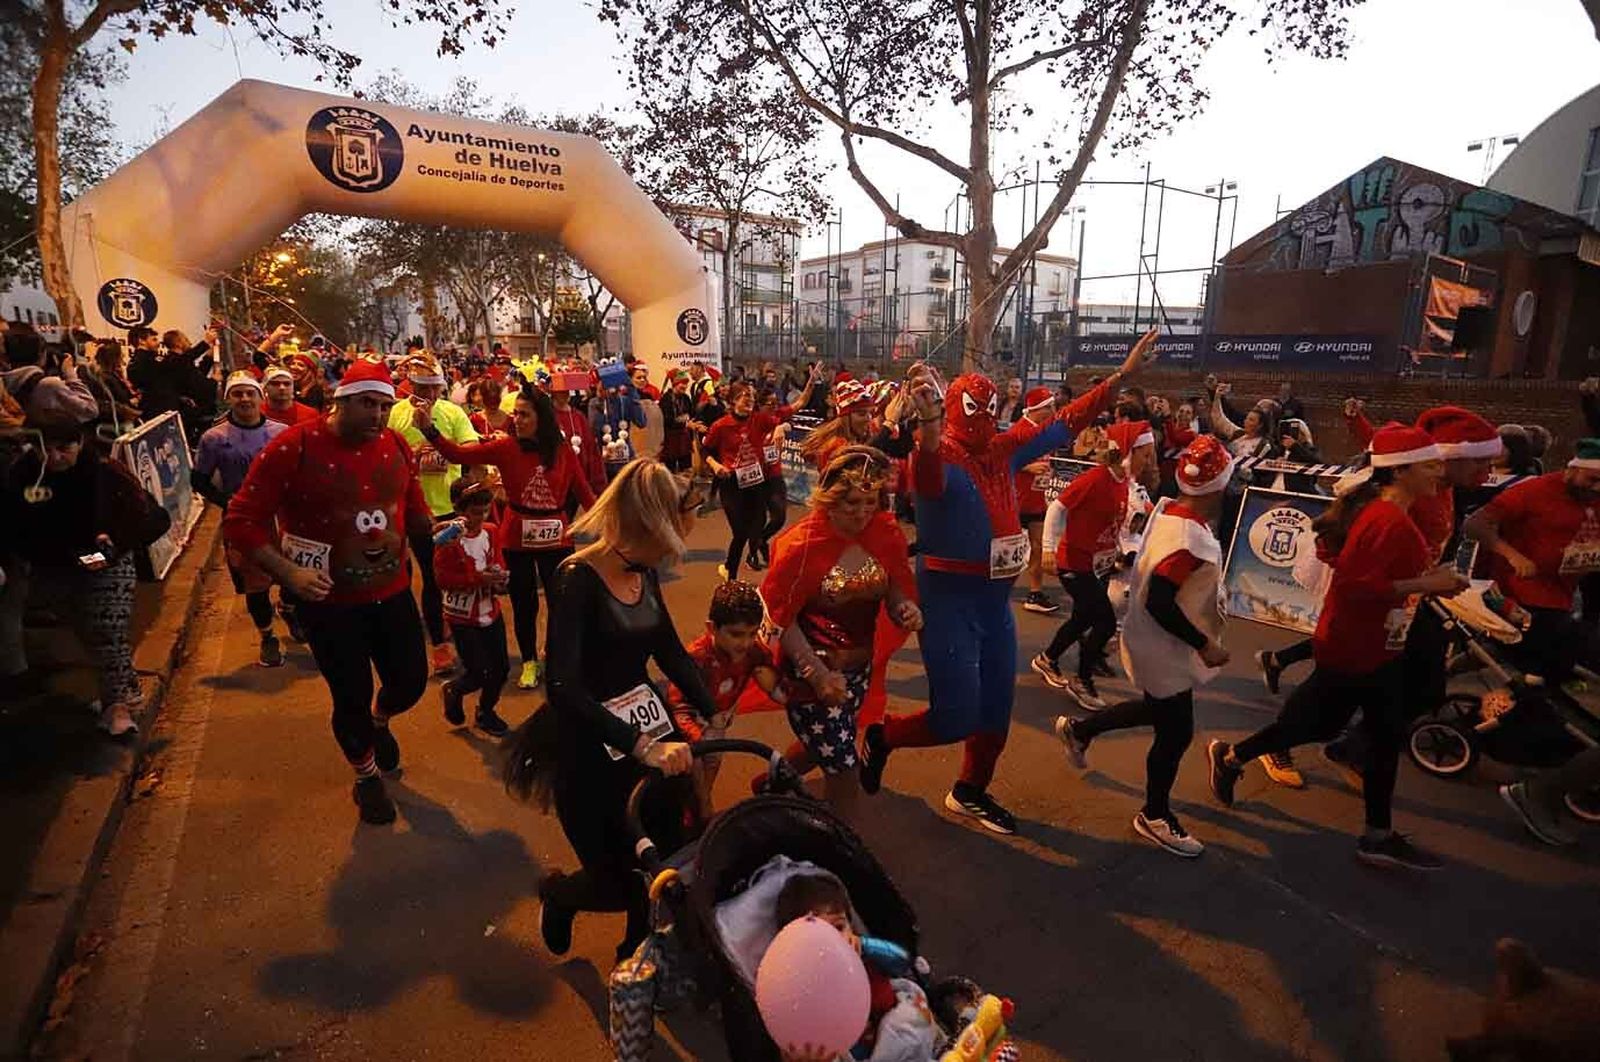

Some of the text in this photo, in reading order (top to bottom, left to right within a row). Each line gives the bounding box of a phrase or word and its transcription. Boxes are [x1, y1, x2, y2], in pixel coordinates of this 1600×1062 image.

[407, 124, 560, 158] Ayuntamiento
[455, 149, 562, 176] de Huelva
[417, 164, 565, 192] Concejalía de Deportes
[1093, 343, 1129, 351] HYUNDAI
[1154, 343, 1194, 351] HYUNDAI
[1234, 343, 1282, 352] HYUNDAI
[1316, 343, 1373, 352] HYUNDAI
[539, 528, 559, 539] 475
[295, 550, 323, 570] 476
[629, 700, 660, 729] 490
